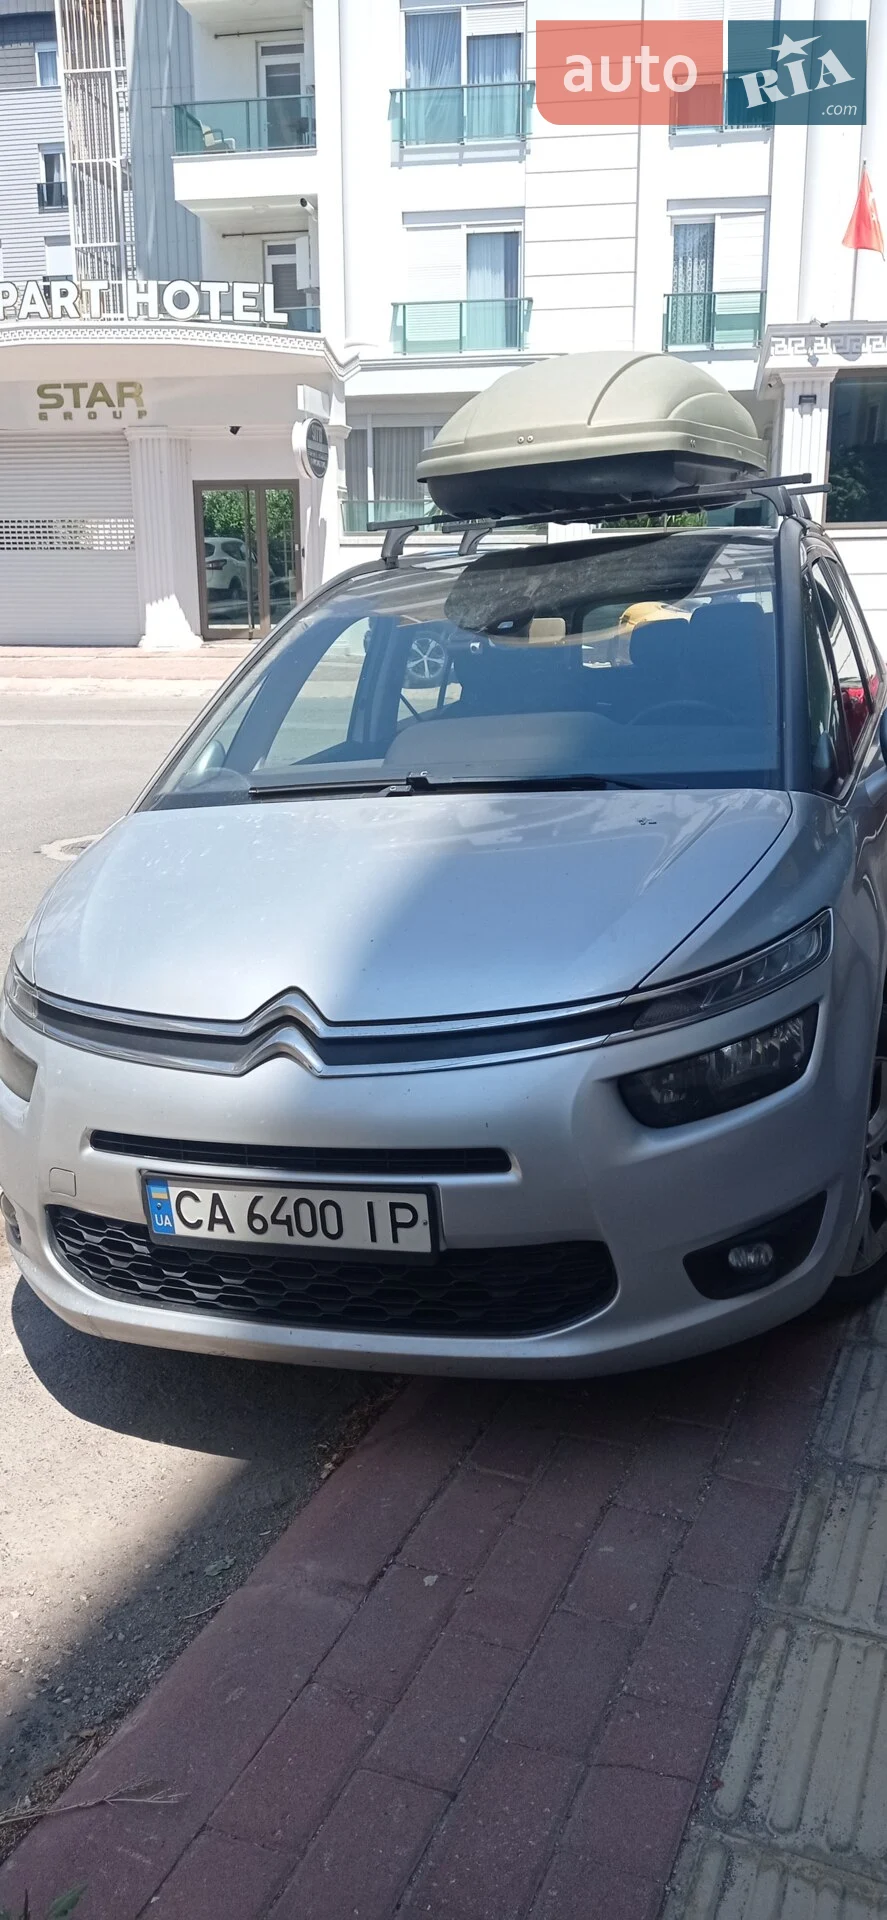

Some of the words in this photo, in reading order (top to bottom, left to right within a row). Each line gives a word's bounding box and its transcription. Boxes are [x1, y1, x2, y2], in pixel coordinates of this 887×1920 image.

[0, 279, 109, 321] PART
[126, 278, 289, 324] HOTEL
[36, 381, 145, 410] STAR
[38, 410, 148, 421] GROUP
[155, 1213, 172, 1227] UA
[174, 1189, 235, 1234] CA
[246, 1195, 344, 1241] 6400
[366, 1200, 419, 1244] IP
